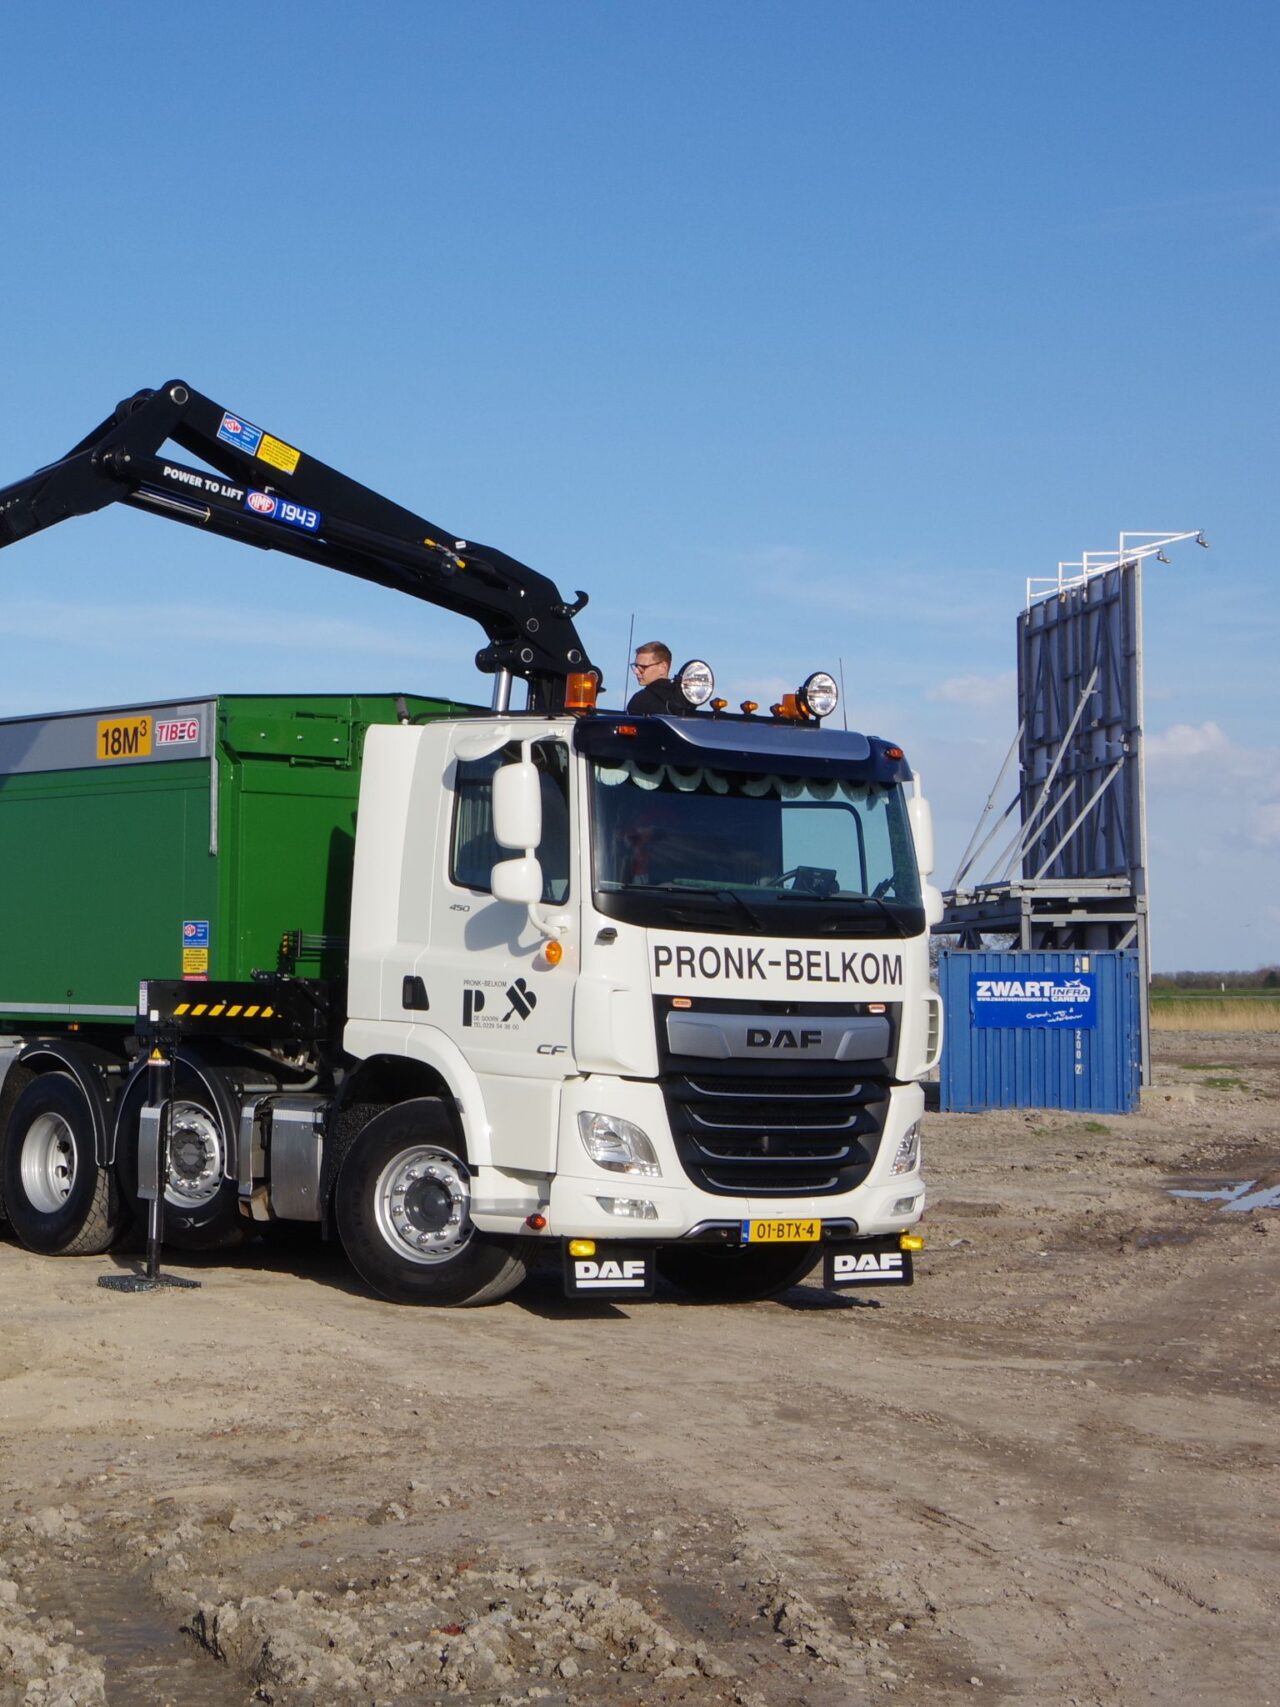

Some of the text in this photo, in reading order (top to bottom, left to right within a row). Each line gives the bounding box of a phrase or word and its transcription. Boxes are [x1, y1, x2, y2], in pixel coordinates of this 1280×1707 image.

[163, 466, 244, 501] POWER TO LIFT
[250, 495, 271, 511] HMF
[280, 503, 317, 528] 1943
[158, 722, 197, 742] TIBEG
[654, 945, 903, 985] PRONK-BELKOM
[463, 979, 507, 988] PRONK-BELKOM
[976, 981, 1089, 997] ZWART INFRA
[746, 1028, 822, 1048] DAF
[537, 1044, 568, 1055] CF
[757, 1222, 815, 1239] 01-BTX-4
[575, 1261, 645, 1279] DAF
[834, 1253, 903, 1273] DAF
